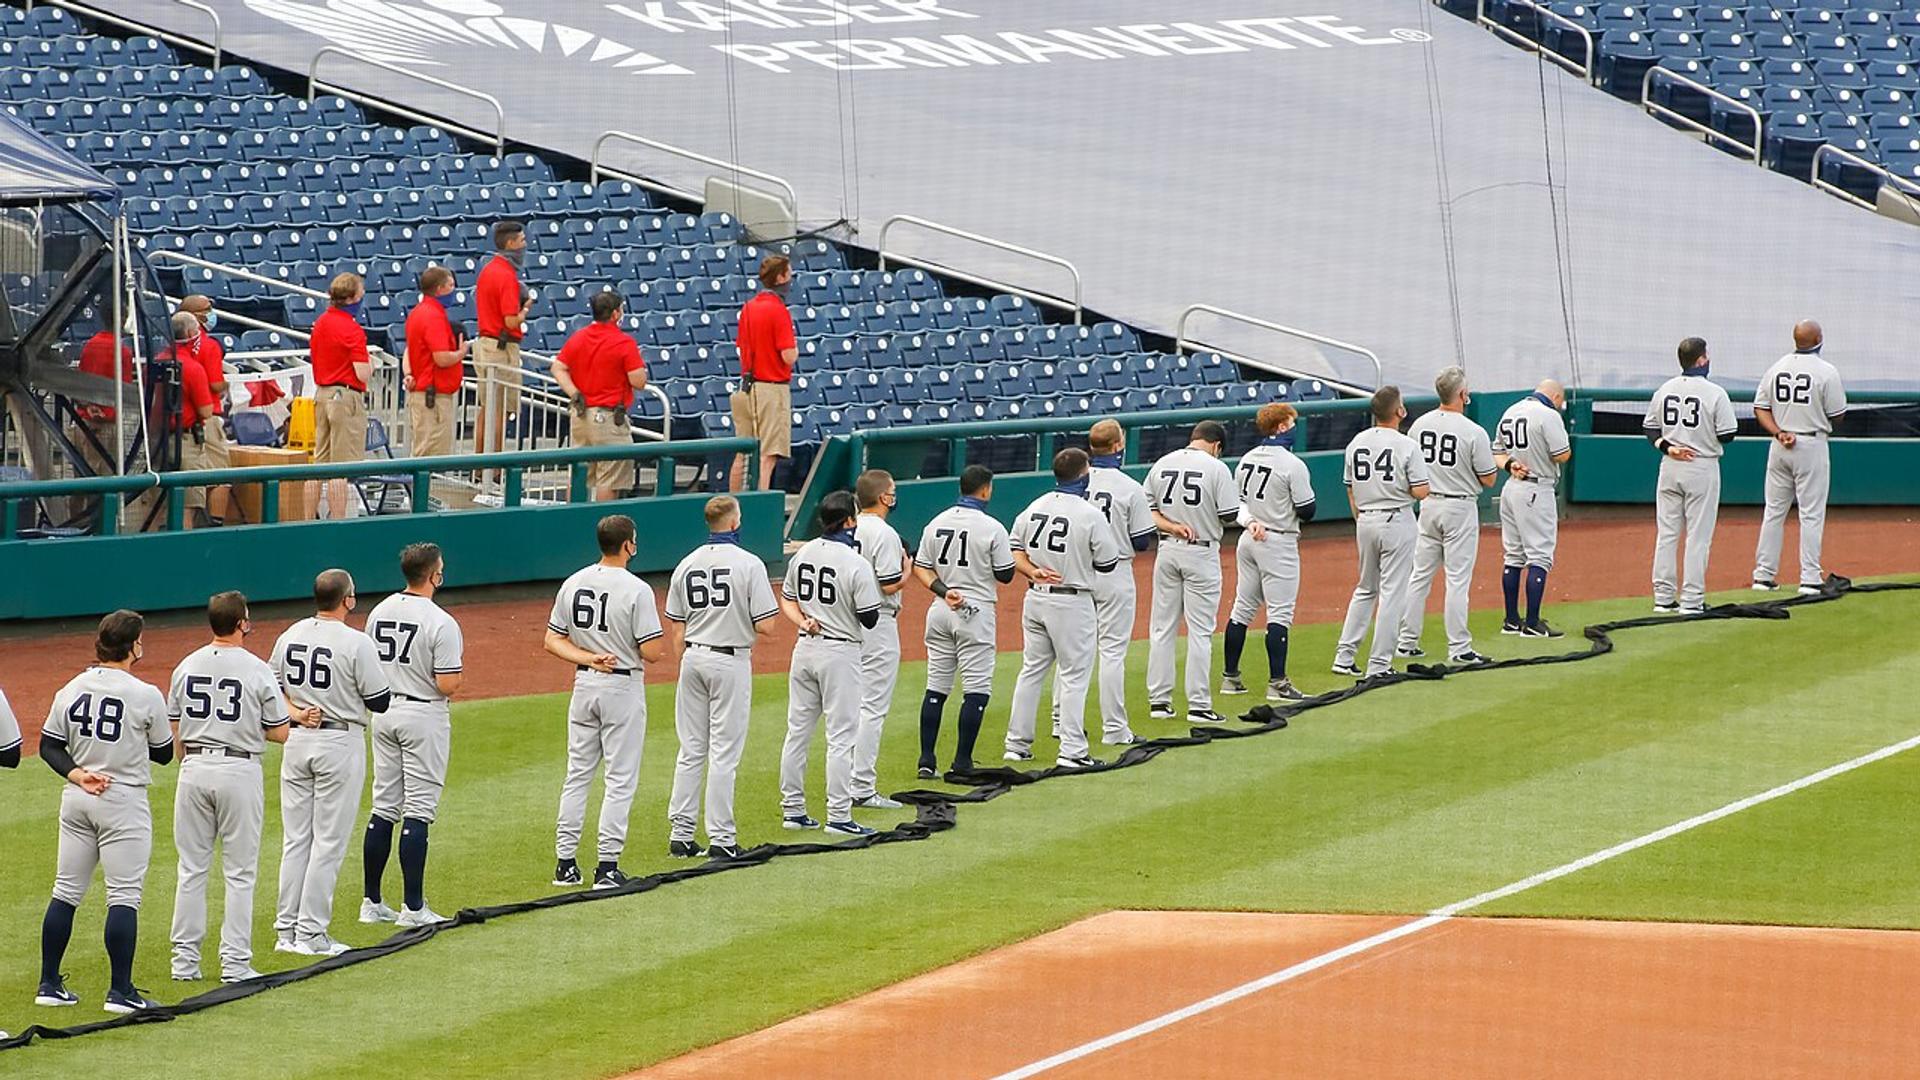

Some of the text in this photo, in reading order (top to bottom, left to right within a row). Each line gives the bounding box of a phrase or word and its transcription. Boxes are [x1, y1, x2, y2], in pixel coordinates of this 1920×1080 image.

[604, 0, 981, 33] KAISER
[1774, 371, 1812, 406] 62
[1662, 394, 1701, 429] 63
[1499, 417, 1530, 451] 50
[1239, 462, 1273, 501] 77
[1352, 447, 1395, 483] 64
[1083, 490, 1114, 525] 3
[1159, 469, 1204, 508] 75
[934, 528, 970, 568] 71
[1028, 512, 1070, 554] 72
[684, 567, 732, 611] 65
[796, 561, 838, 607] 66
[571, 587, 610, 634] 61
[374, 619, 420, 665] 57
[284, 642, 334, 691] 56
[67, 692, 125, 744] 48
[184, 674, 244, 724] 53
